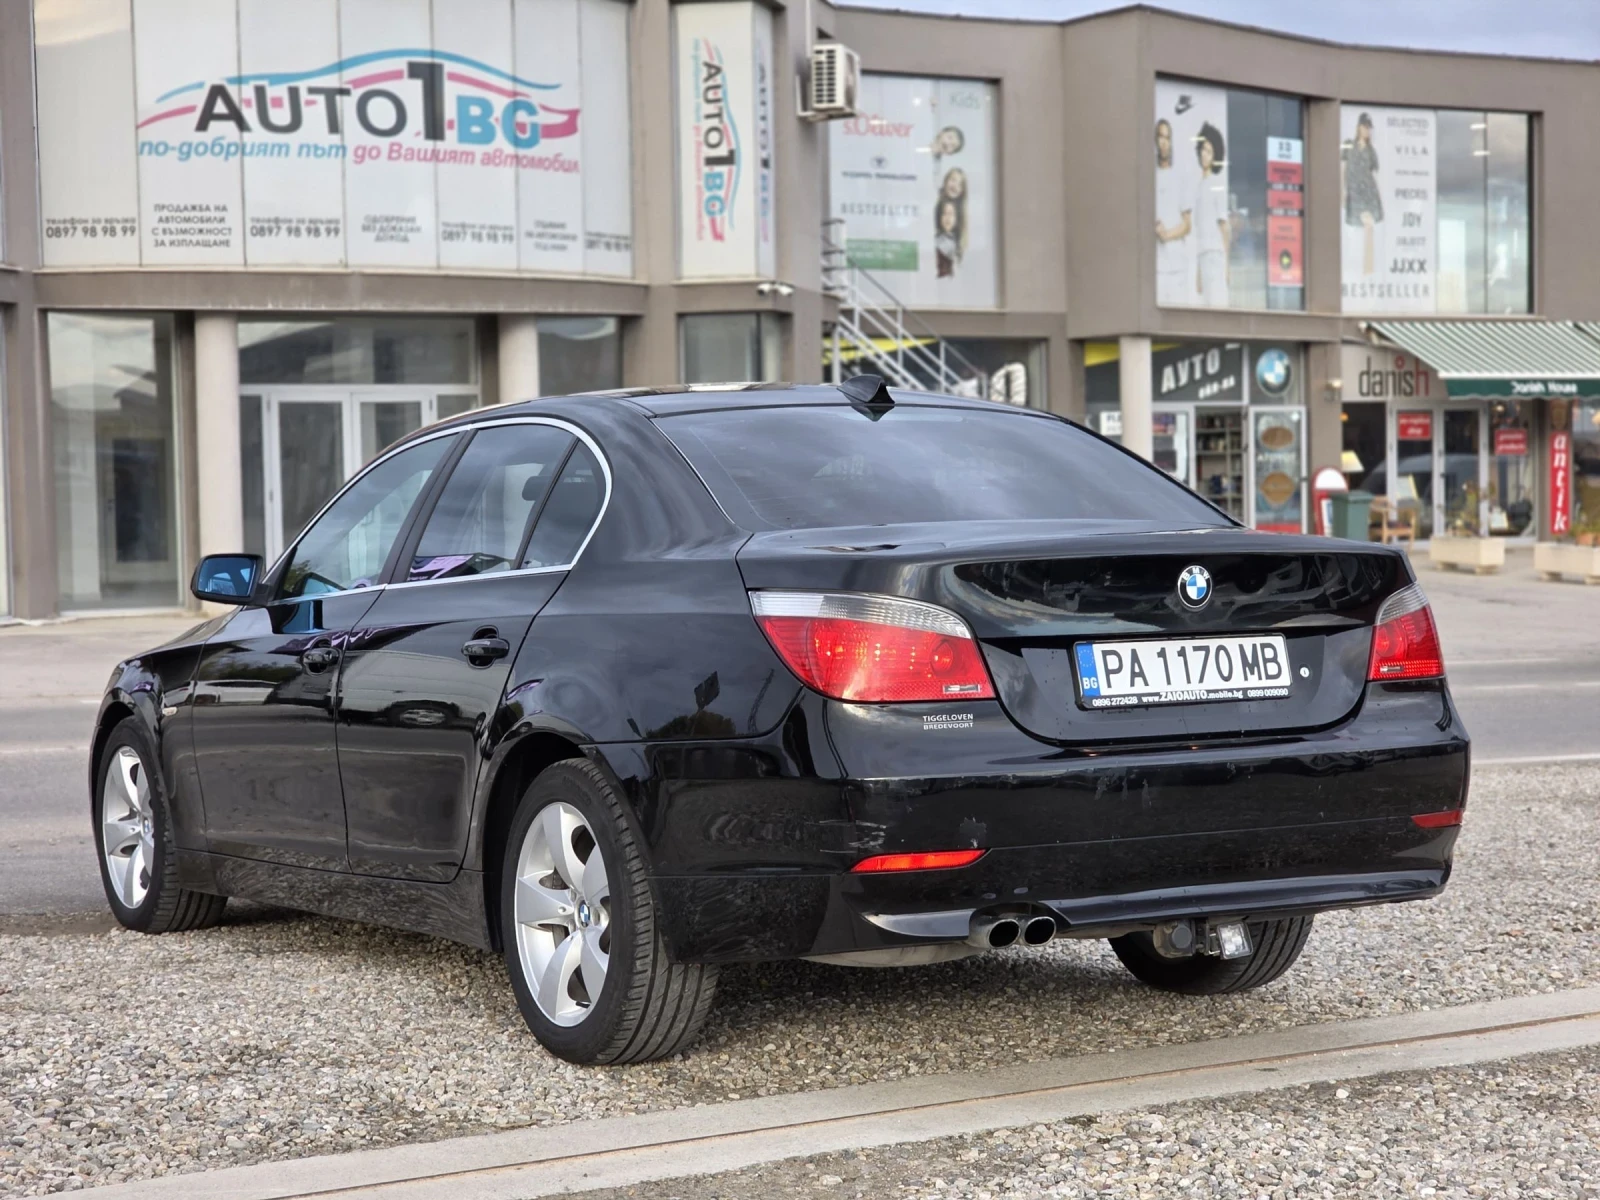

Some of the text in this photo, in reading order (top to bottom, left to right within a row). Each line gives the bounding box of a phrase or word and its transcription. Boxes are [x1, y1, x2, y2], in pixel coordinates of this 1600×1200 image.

[138, 135, 290, 162] по-добрият
[297, 141, 347, 158] път
[353, 144, 381, 165] до
[387, 142, 475, 165] Вашият
[1395, 145, 1429, 156] VILA
[154, 204, 228, 213] ПРОДАЖБА НА
[157, 215, 226, 225] АВТОМОБИЛИ
[46, 225, 136, 239] 0897 98 98 99
[152, 227, 232, 237] С ВЪЗМОЖНОСТ
[250, 226, 340, 238] 0897 98 98 99
[154, 239, 231, 249] ЗА ИЗПЛАЩАНЕ
[1389, 258, 1428, 274] JJXX
[1341, 282, 1430, 299] BESTSELLER
[1358, 355, 1430, 398] danish
[1553, 434, 1568, 532] antik
[1101, 642, 1282, 689] PA 1170 MB
[1083, 677, 1098, 689] BG
[1111, 696, 1138, 706] 272428
[922, 713, 974, 722] TIGGELOVEN
[923, 722, 974, 730] BREDEVOORT
